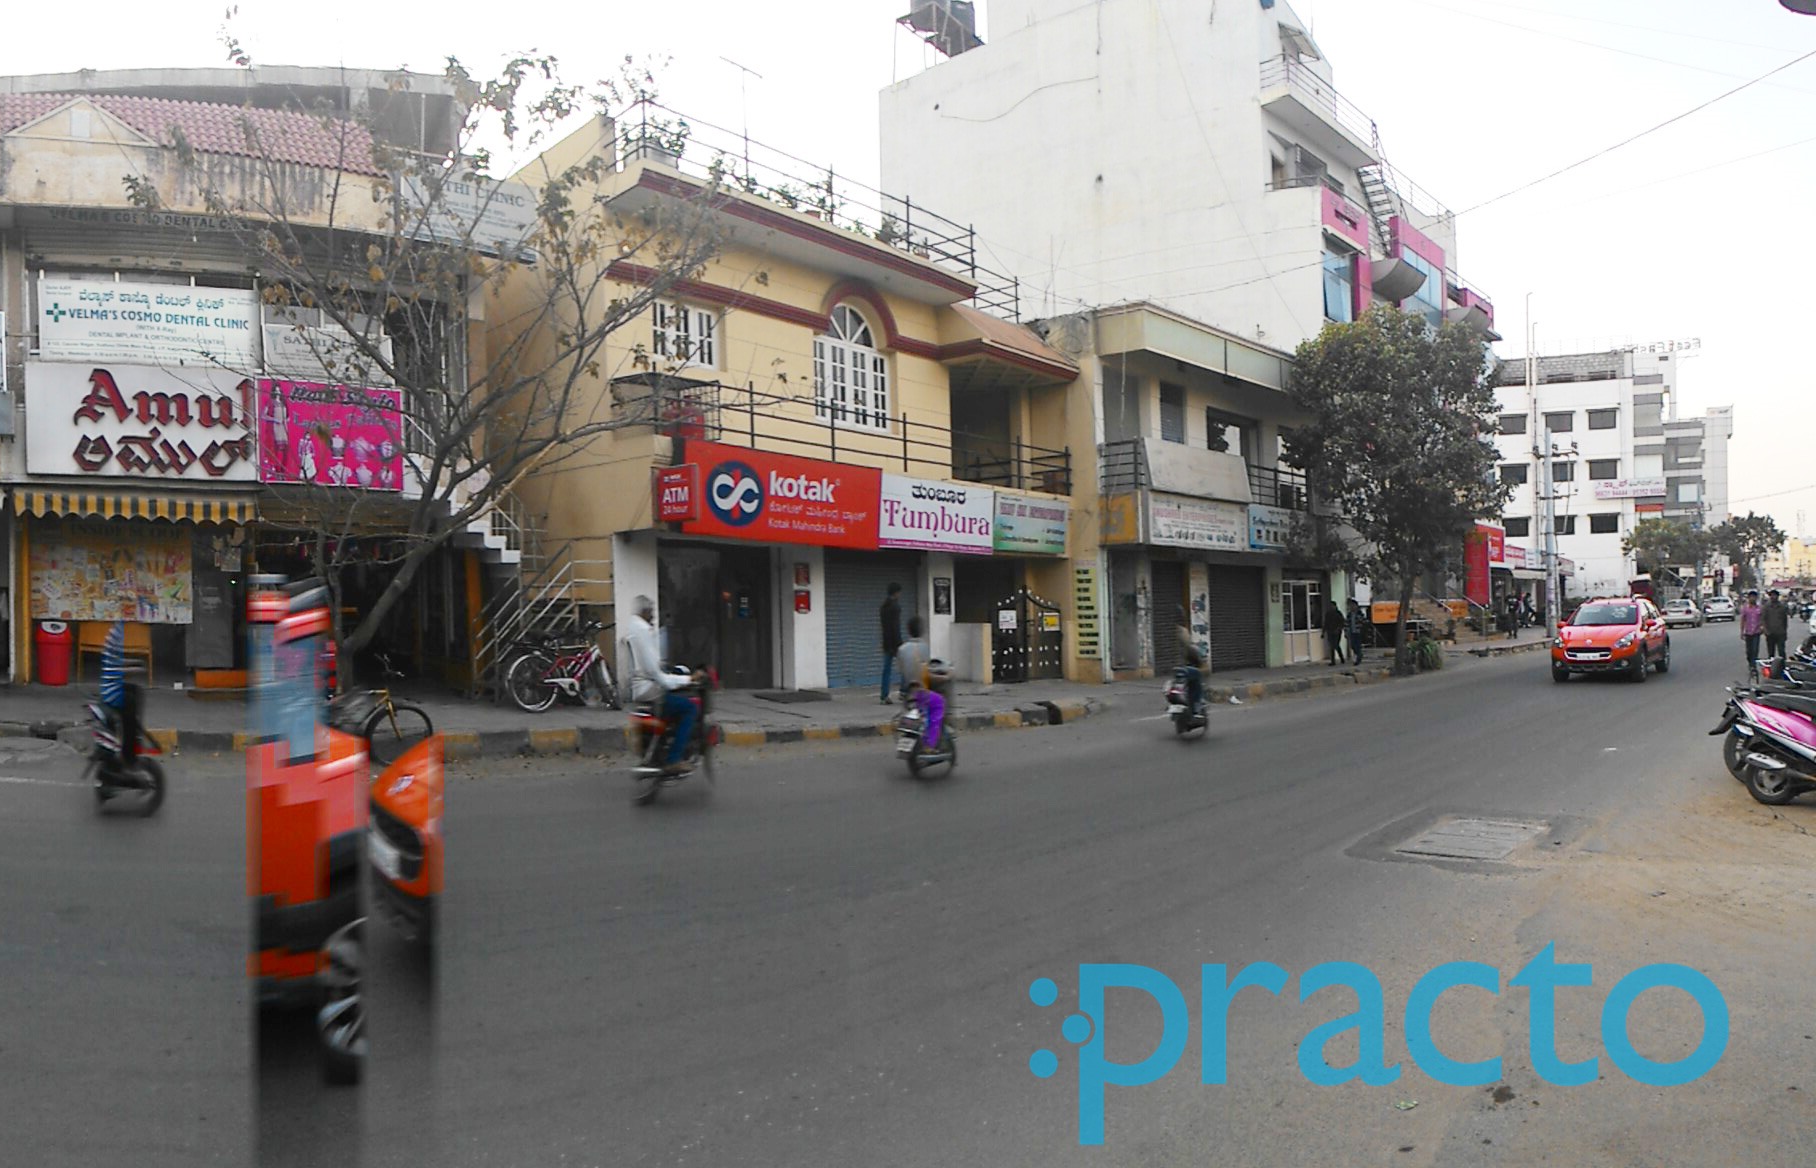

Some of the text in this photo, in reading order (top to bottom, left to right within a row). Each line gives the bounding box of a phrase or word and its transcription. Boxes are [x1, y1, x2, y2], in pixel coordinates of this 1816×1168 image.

[68, 308, 249, 331] VELMA'S COSMO DENTAL CLINIC
[73, 368, 253, 429] Amul
[662, 486, 689, 503] ATM
[769, 470, 835, 503] kotak
[768, 518, 845, 534] Kotak Mahindra Bank
[883, 499, 991, 538] Tumbura
